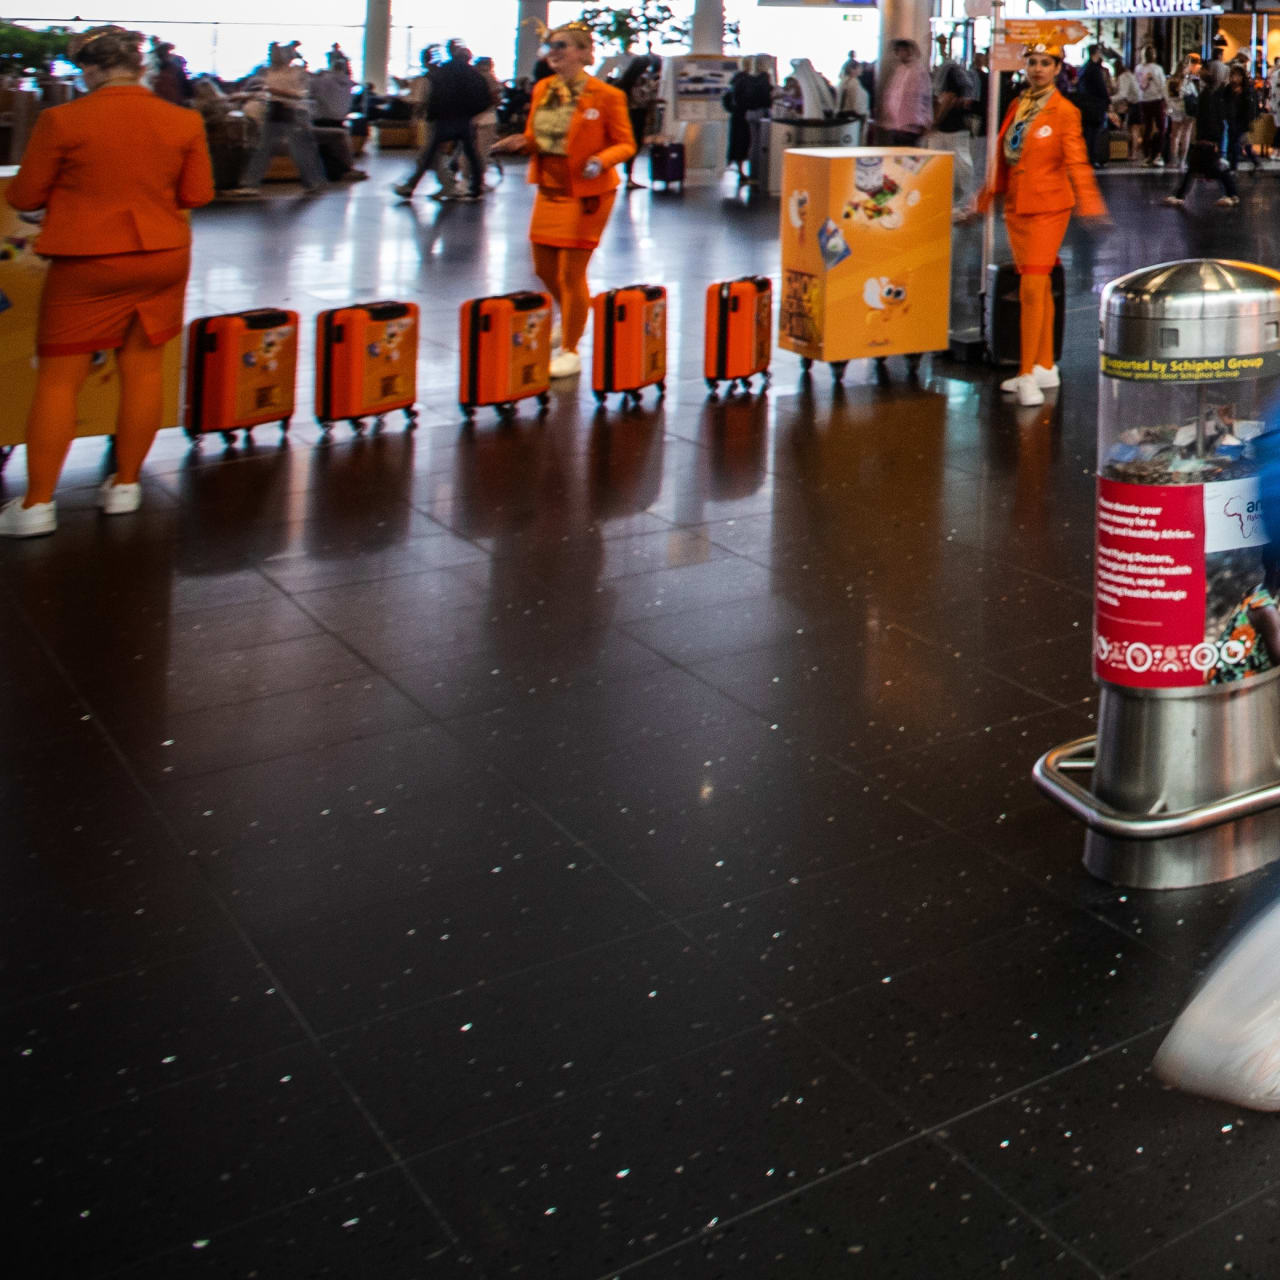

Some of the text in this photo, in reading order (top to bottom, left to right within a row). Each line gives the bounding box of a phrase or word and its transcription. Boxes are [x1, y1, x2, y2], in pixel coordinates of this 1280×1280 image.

[1151, 359, 1168, 373] by
[1169, 359, 1225, 373] Schiphol
[1227, 357, 1264, 370] Group
